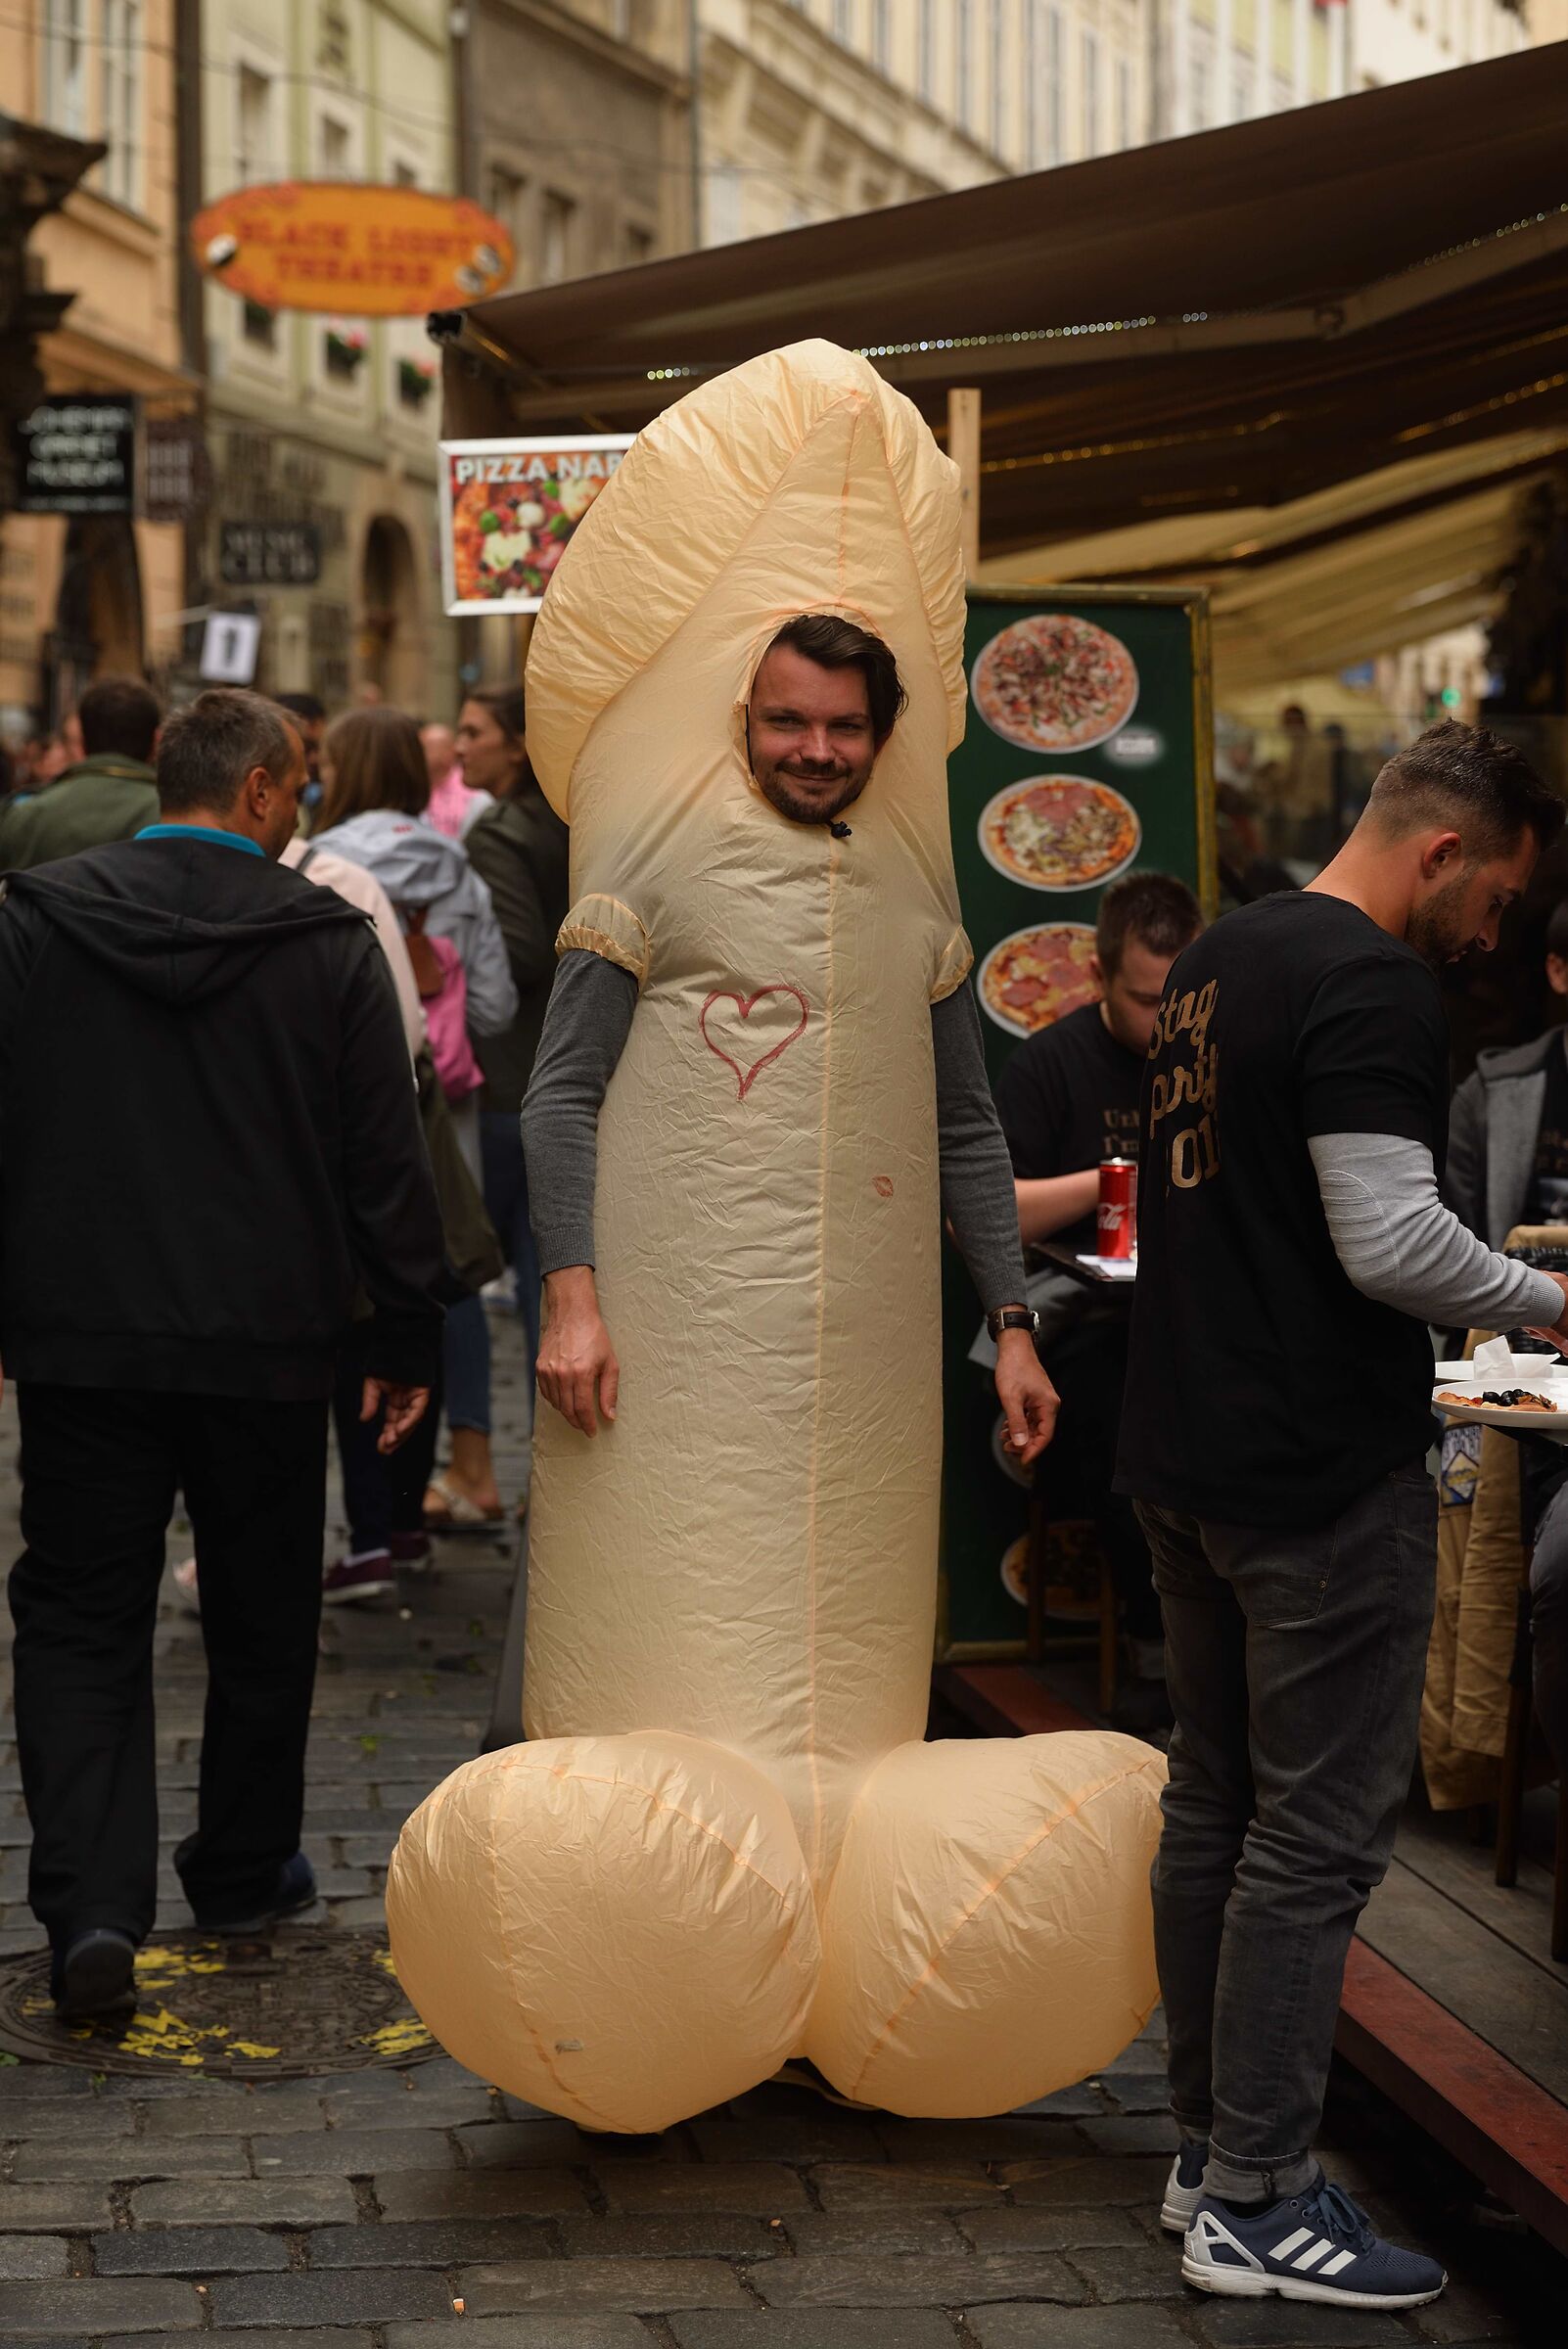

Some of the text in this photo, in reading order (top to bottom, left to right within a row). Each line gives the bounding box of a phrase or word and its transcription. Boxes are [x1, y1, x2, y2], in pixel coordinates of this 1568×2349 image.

[241, 219, 348, 250] BLACK
[276, 253, 433, 287] THEATRE
[455, 456, 547, 484] PIZZA
[1147, 979, 1220, 1059] Stag
[1149, 1042, 1220, 1140] prty
[1167, 1115, 1221, 1196] 01
